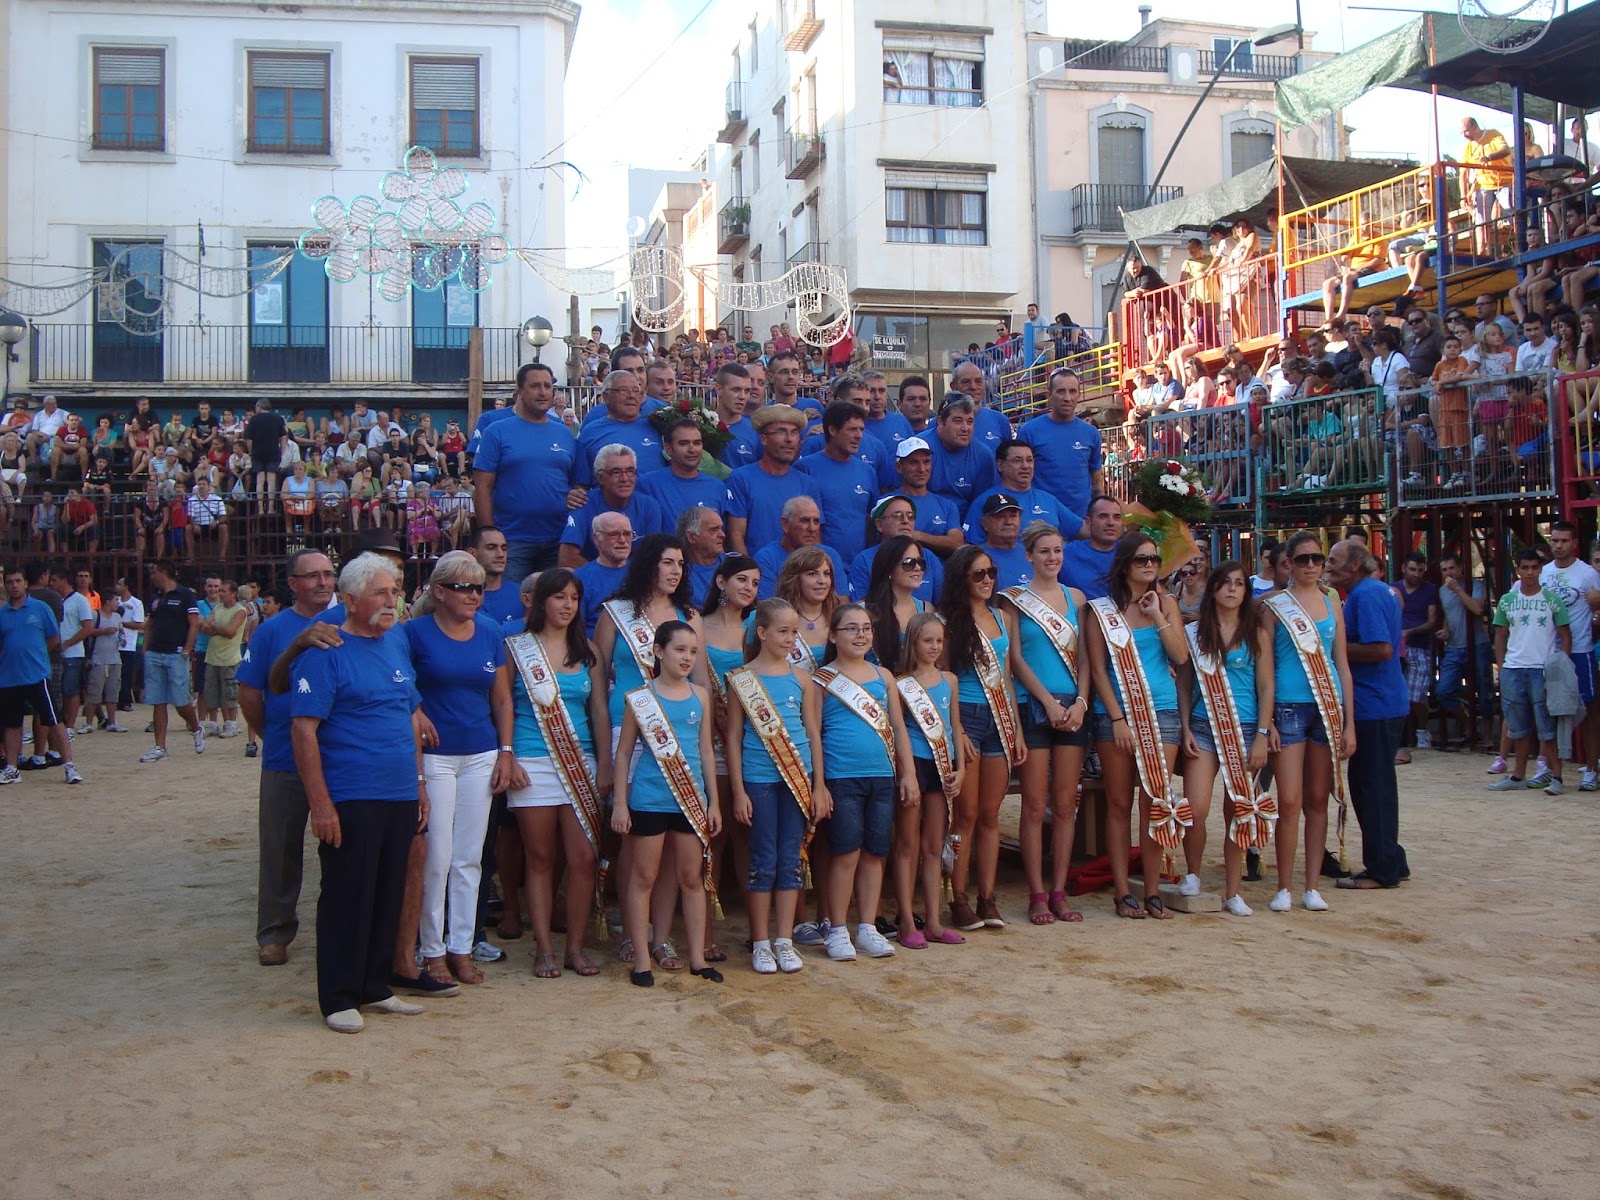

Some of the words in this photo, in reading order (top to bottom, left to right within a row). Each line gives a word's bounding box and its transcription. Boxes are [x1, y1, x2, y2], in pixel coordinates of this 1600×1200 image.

[875, 336, 882, 345] SE
[883, 337, 905, 345] ALQUILA
[1546, 572, 1565, 581] THE
[739, 678, 752, 687] 2011
[636, 697, 650, 706] 2011
